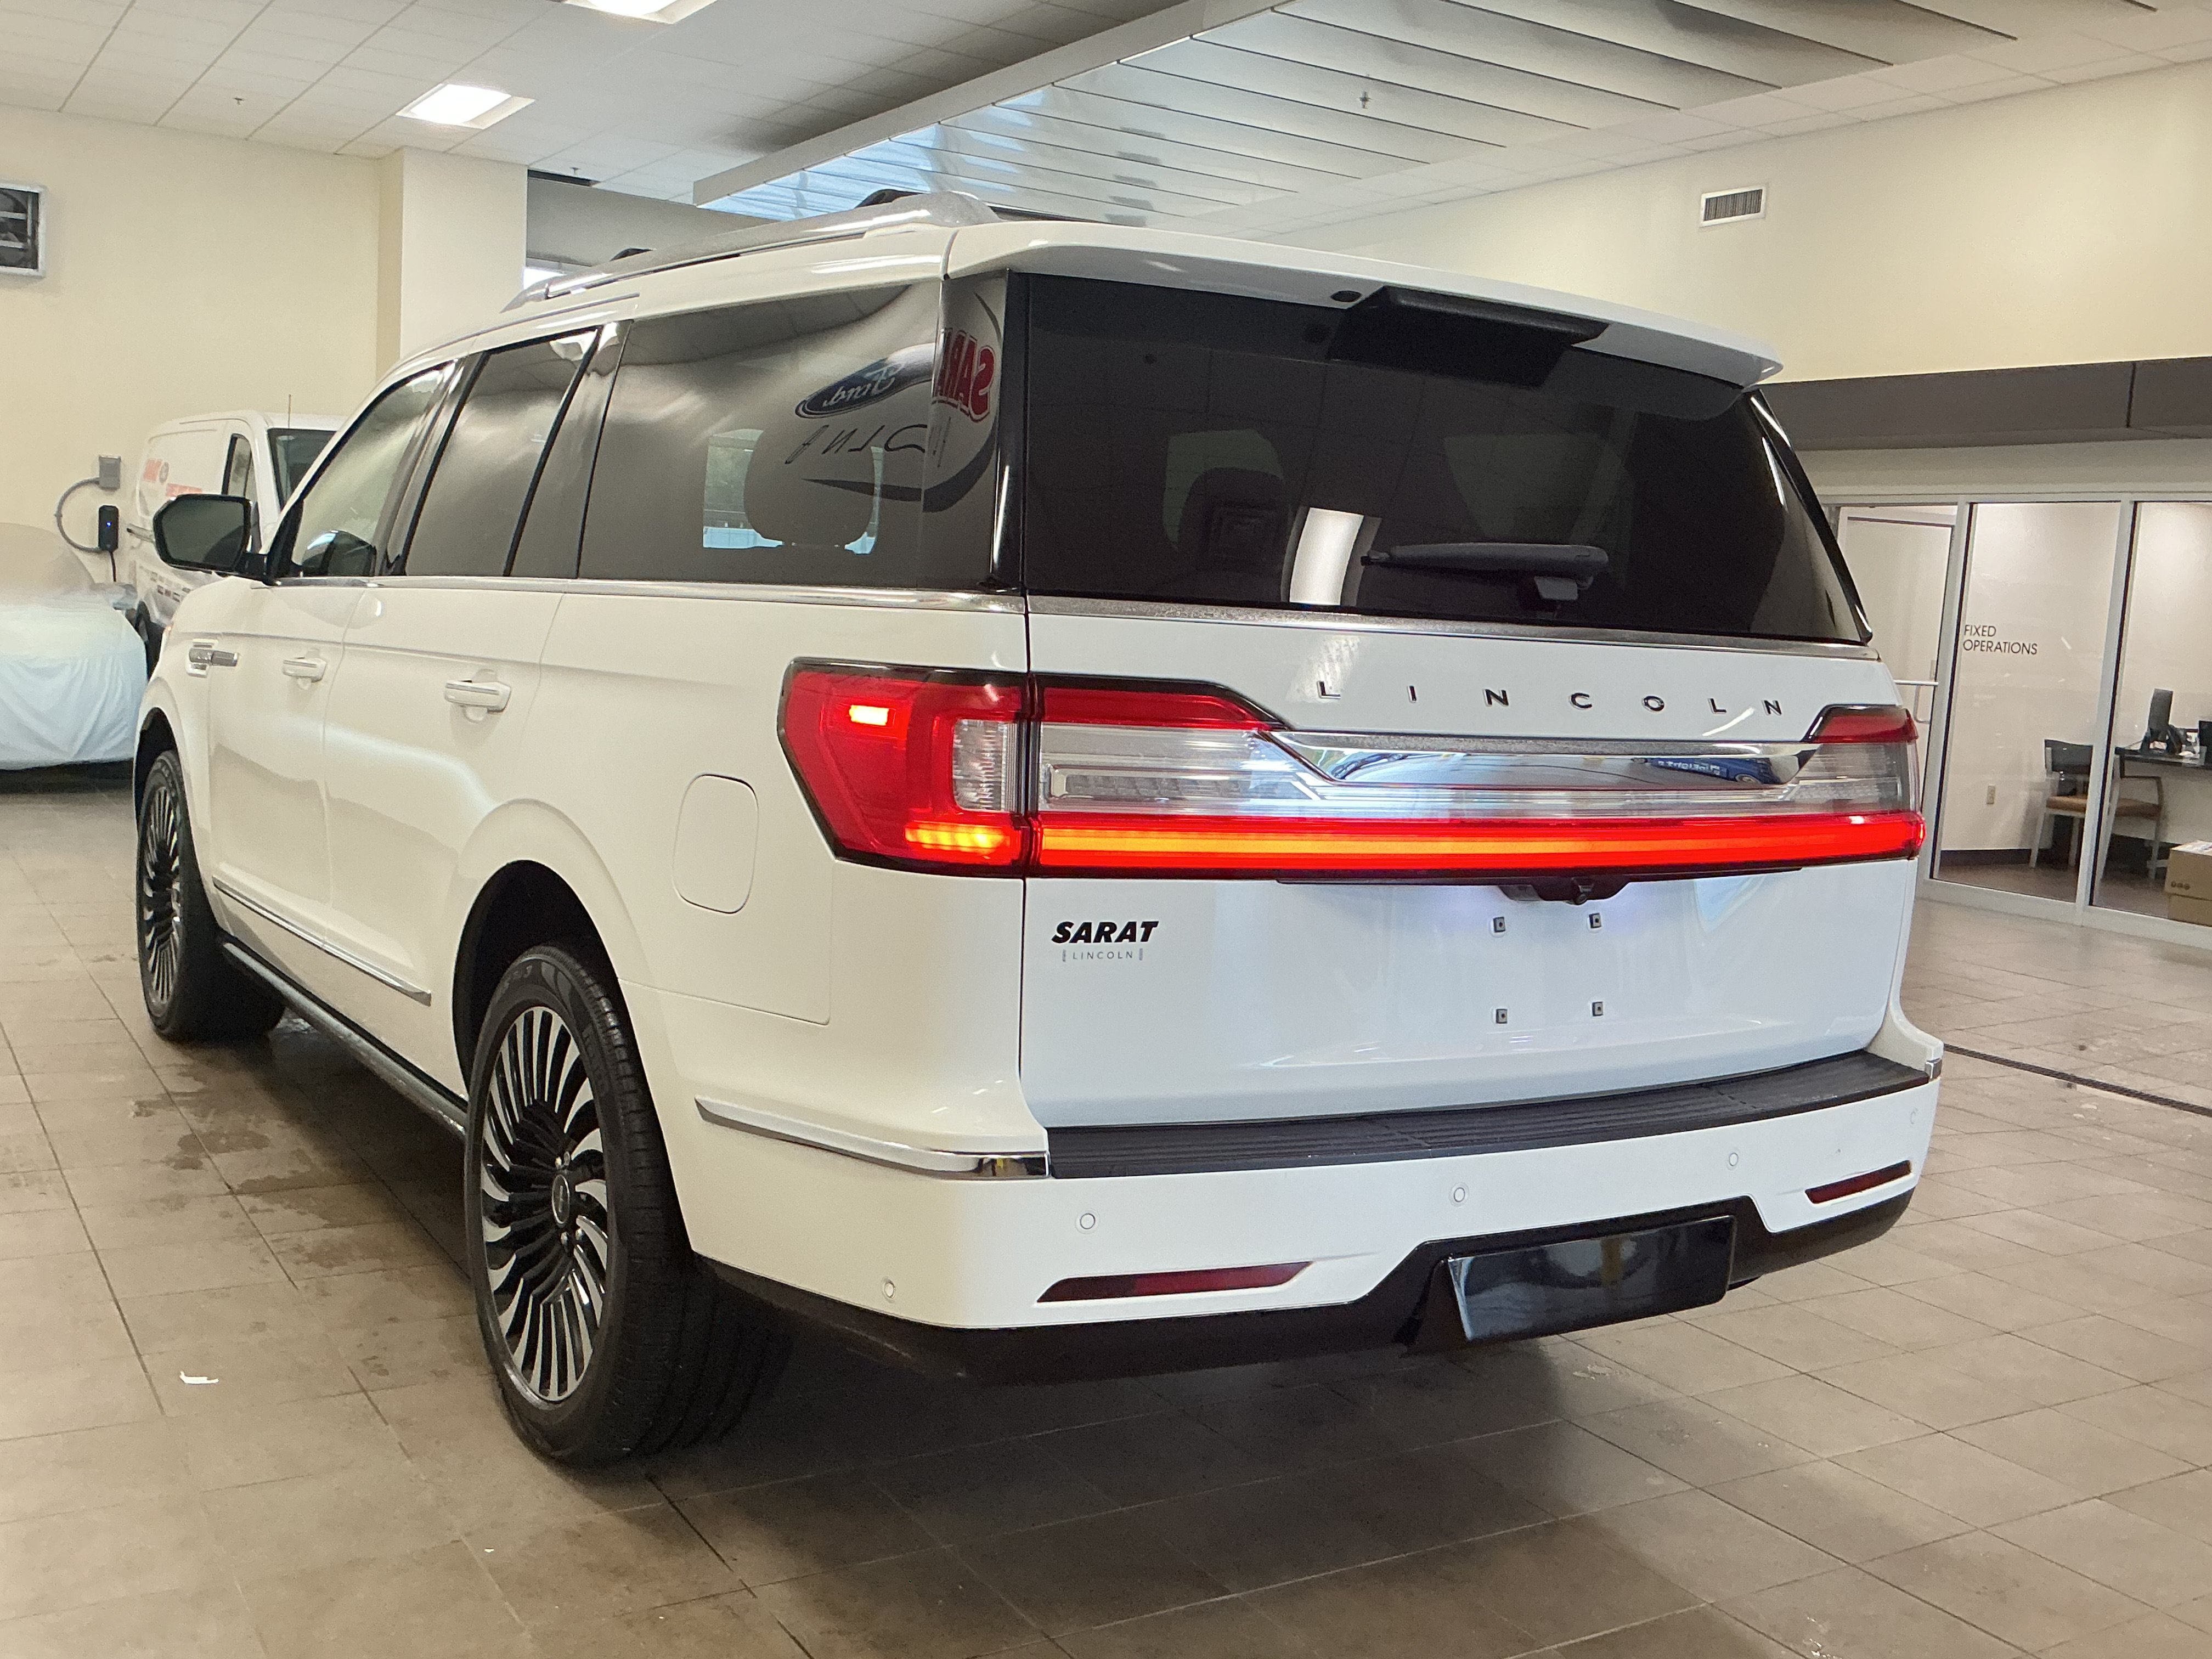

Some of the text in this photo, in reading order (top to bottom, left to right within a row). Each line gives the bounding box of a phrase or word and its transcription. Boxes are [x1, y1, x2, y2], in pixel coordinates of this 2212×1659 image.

[1963, 624, 1997, 637] FIXED
[1963, 639, 2038, 655] OPERATIONS
[1317, 680, 1783, 715] LINCOLN
[1051, 921, 1159, 944] SARAT
[1073, 951, 1133, 960] LINCOLN
